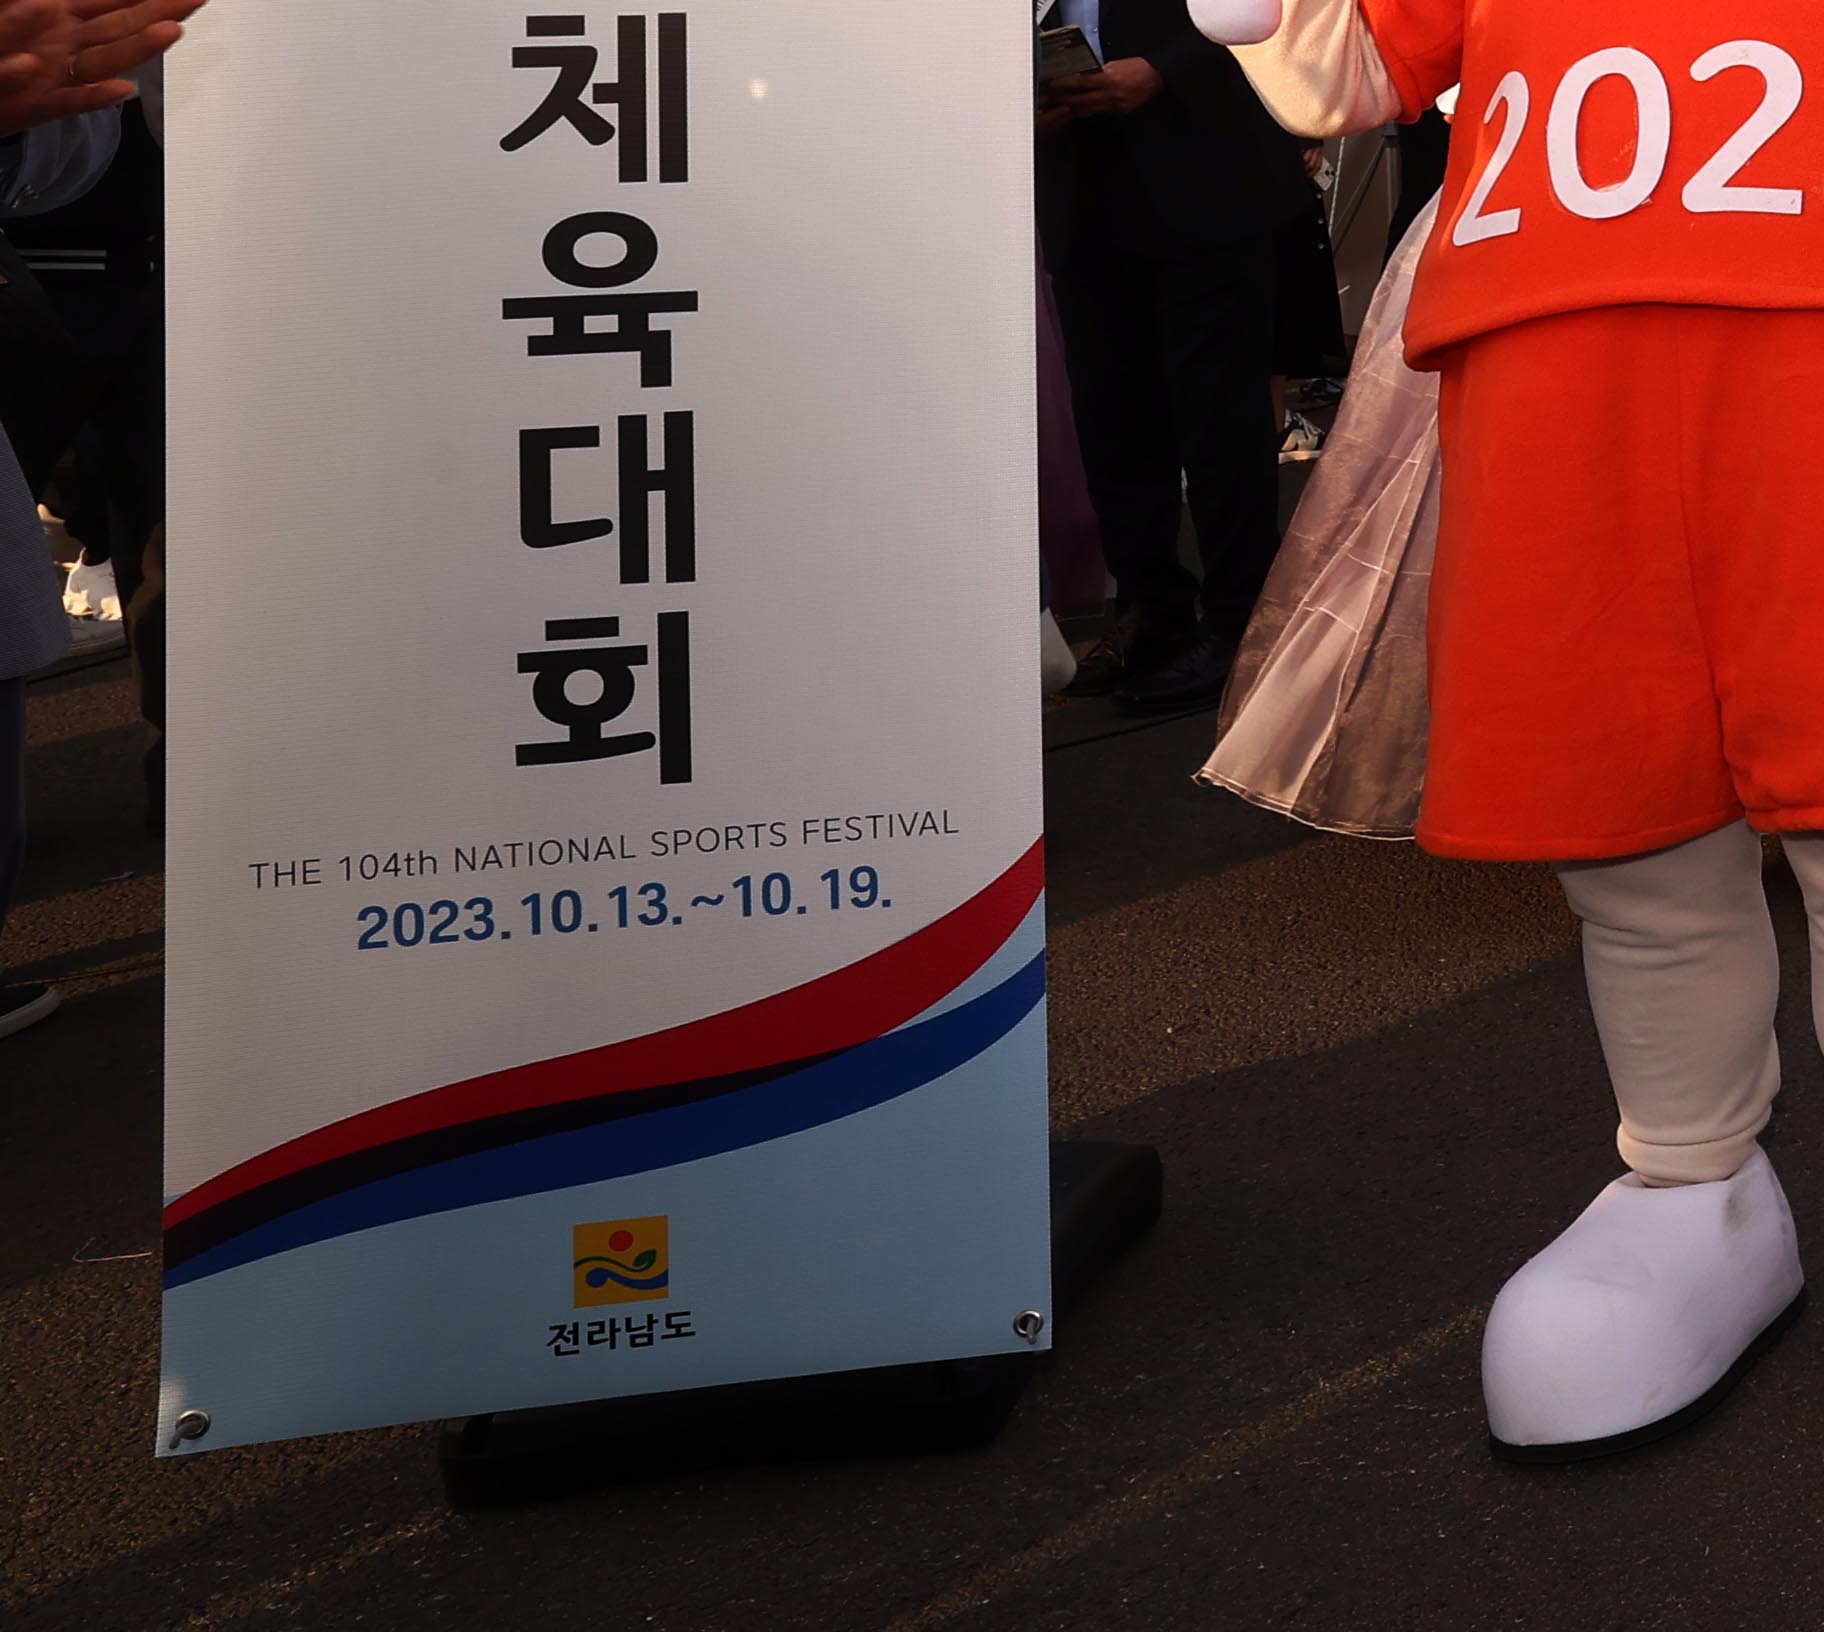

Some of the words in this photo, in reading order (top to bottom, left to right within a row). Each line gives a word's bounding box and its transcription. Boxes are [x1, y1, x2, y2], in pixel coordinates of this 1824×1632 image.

[248, 858, 323, 891] THE
[338, 848, 440, 884] 104th
[453, 832, 637, 873] NATIONAL
[650, 820, 789, 858] SPORTS
[802, 808, 960, 846] FESTIVAL
[546, 1308, 697, 1358] 전라남도
